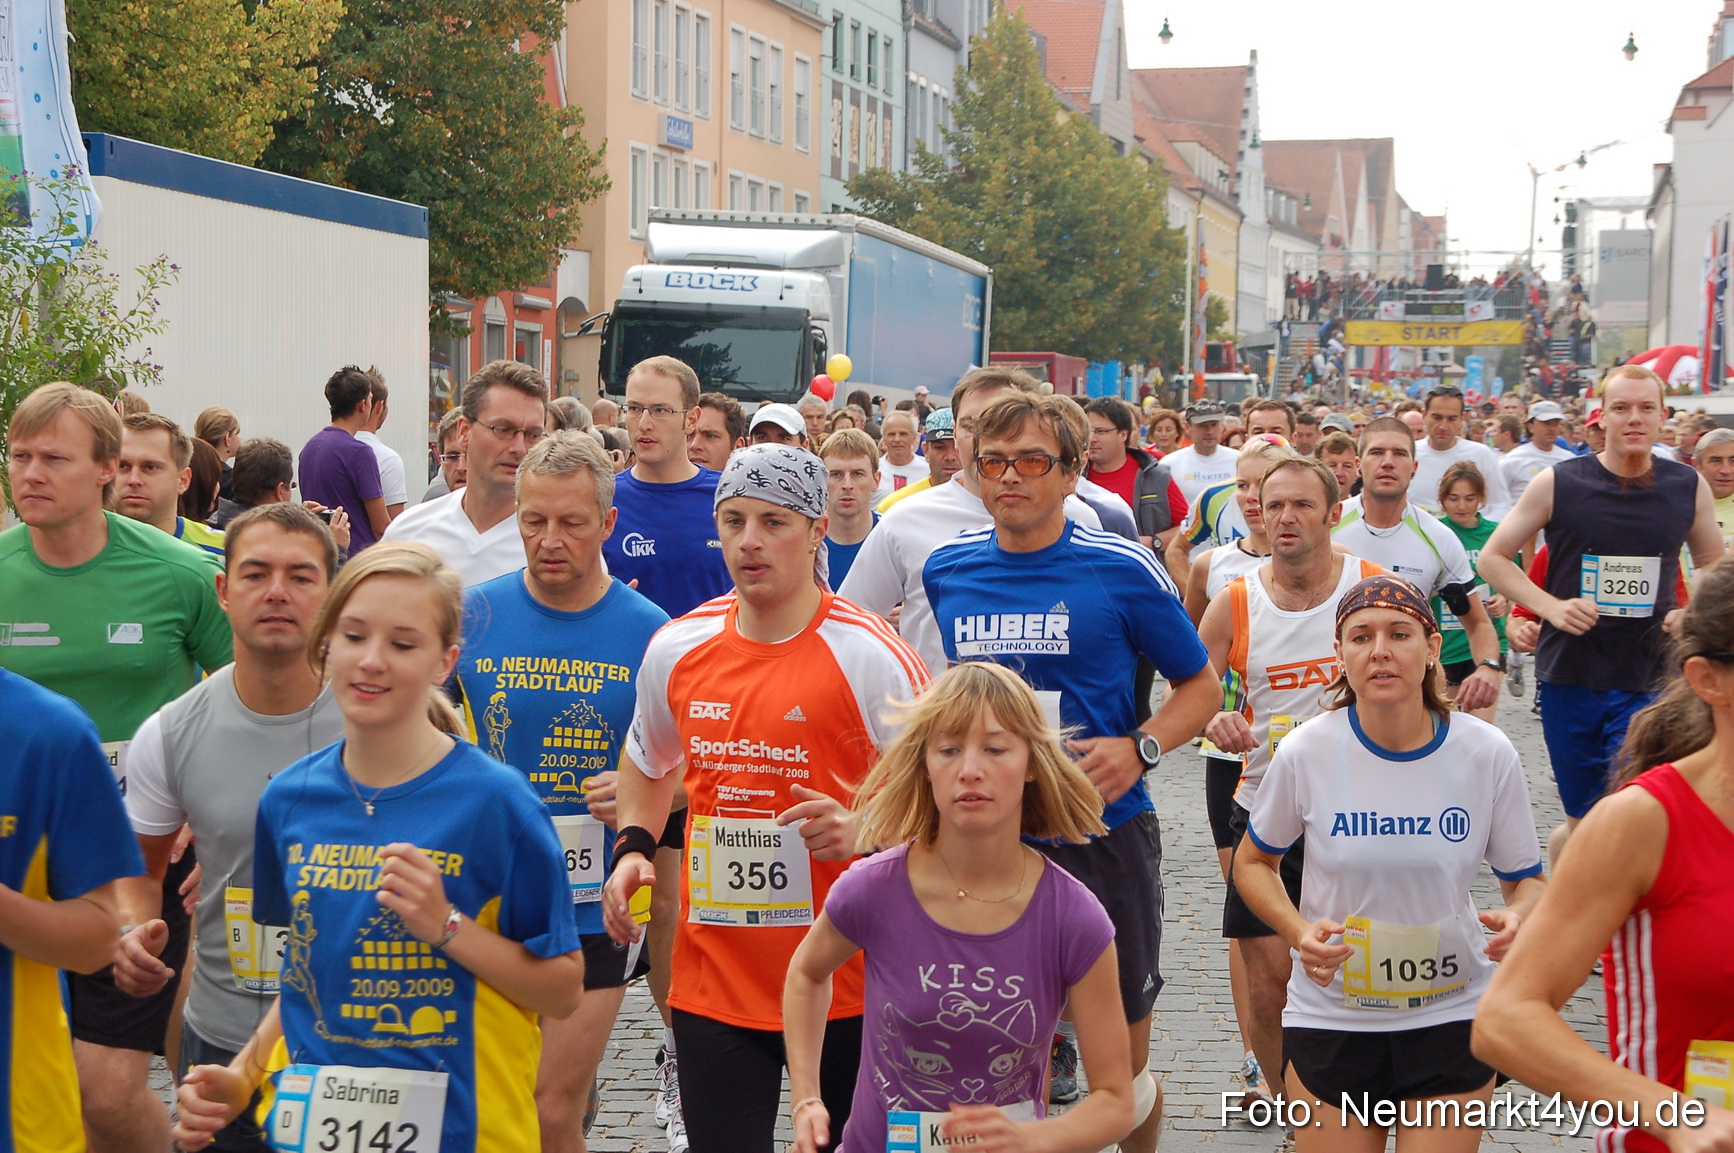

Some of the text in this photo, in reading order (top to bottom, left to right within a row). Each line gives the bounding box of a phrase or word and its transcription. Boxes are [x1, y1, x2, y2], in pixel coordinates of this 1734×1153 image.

[665, 271, 759, 292] BOCK
[1402, 326, 1462, 340] START
[1603, 562, 1642, 573] Andreas
[1604, 580, 1649, 595] 3260
[954, 613, 1069, 643] HUBER
[977, 642, 1063, 652] TECHNOLOGY
[475, 656, 631, 683] 10. NEUMARKTER
[495, 673, 604, 694] STADTLAUF
[689, 701, 732, 721] DAK
[690, 736, 809, 763] SportScheck
[702, 760, 746, 773] Nürnberger
[746, 762, 783, 776] Stadtlauf
[785, 767, 810, 779] 2008
[1330, 811, 1432, 836] Allianz
[715, 826, 782, 848] Matthias
[692, 856, 699, 871] B
[727, 861, 788, 890] 356
[571, 888, 601, 898] LEIDERER
[760, 908, 811, 919] PFLEIDERER
[233, 928, 241, 942] B
[1379, 953, 1459, 982] 1035
[351, 978, 455, 998] 20.09.2009
[919, 963, 1025, 999] KISS
[323, 1076, 399, 1105] Sabrina
[282, 1111, 292, 1128] D
[319, 1117, 419, 1153] 3142
